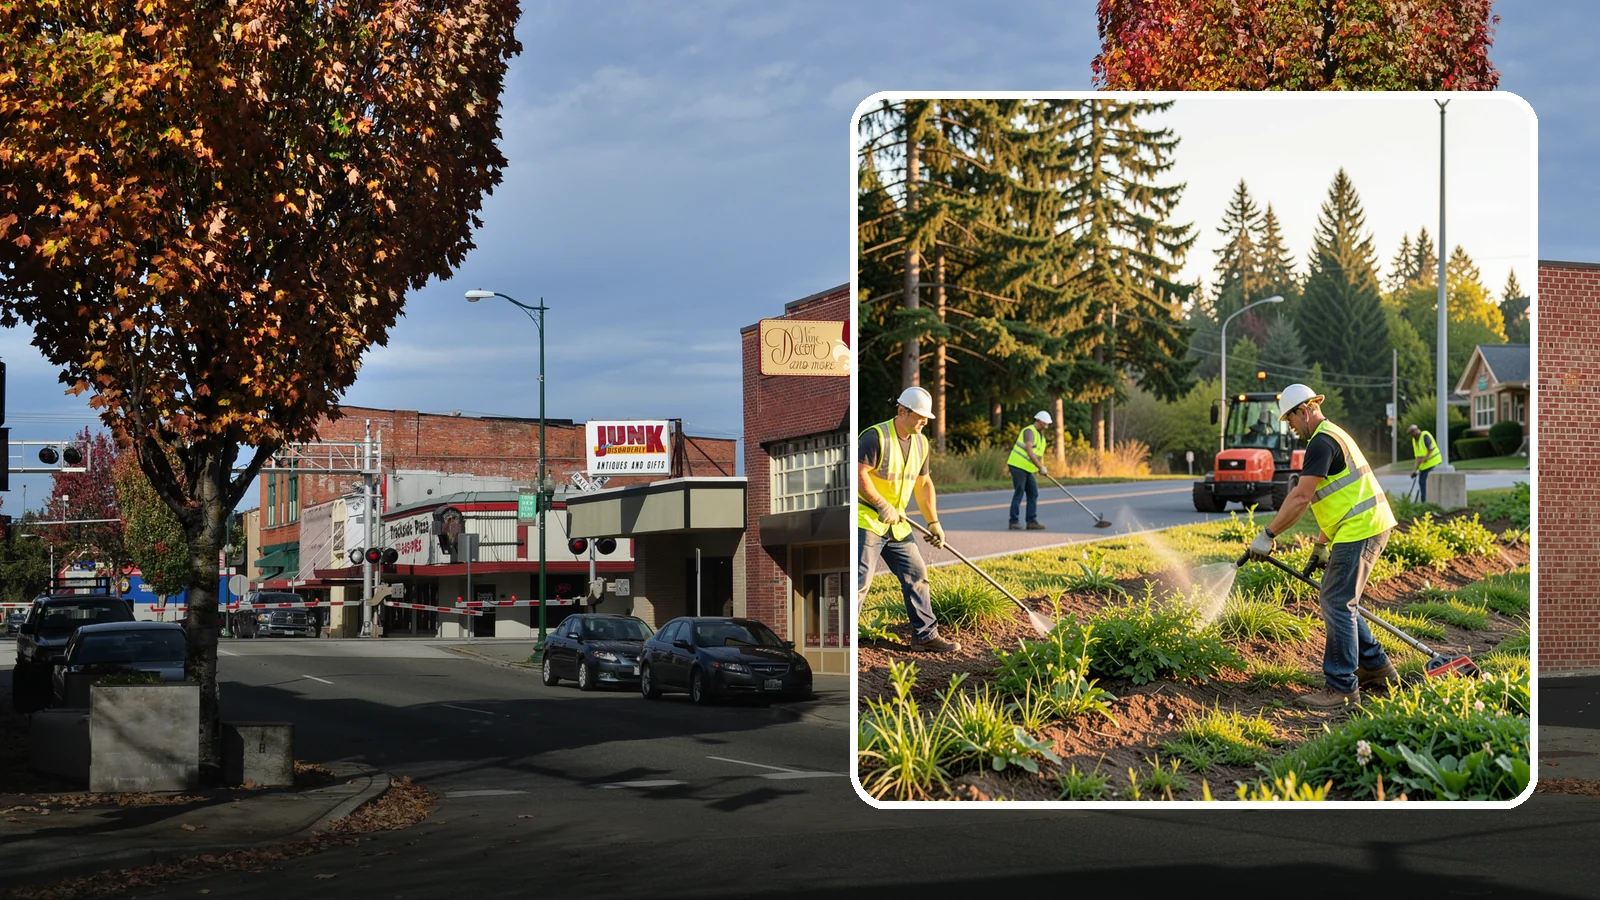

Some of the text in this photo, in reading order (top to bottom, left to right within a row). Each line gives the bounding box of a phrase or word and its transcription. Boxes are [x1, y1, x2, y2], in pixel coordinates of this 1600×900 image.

[765, 327, 830, 365] Decor
[595, 425, 664, 456] JUNK
[597, 460, 665, 470] ANTIQUES AND GIFTS
[390, 519, 429, 540] Trackside Pizza
